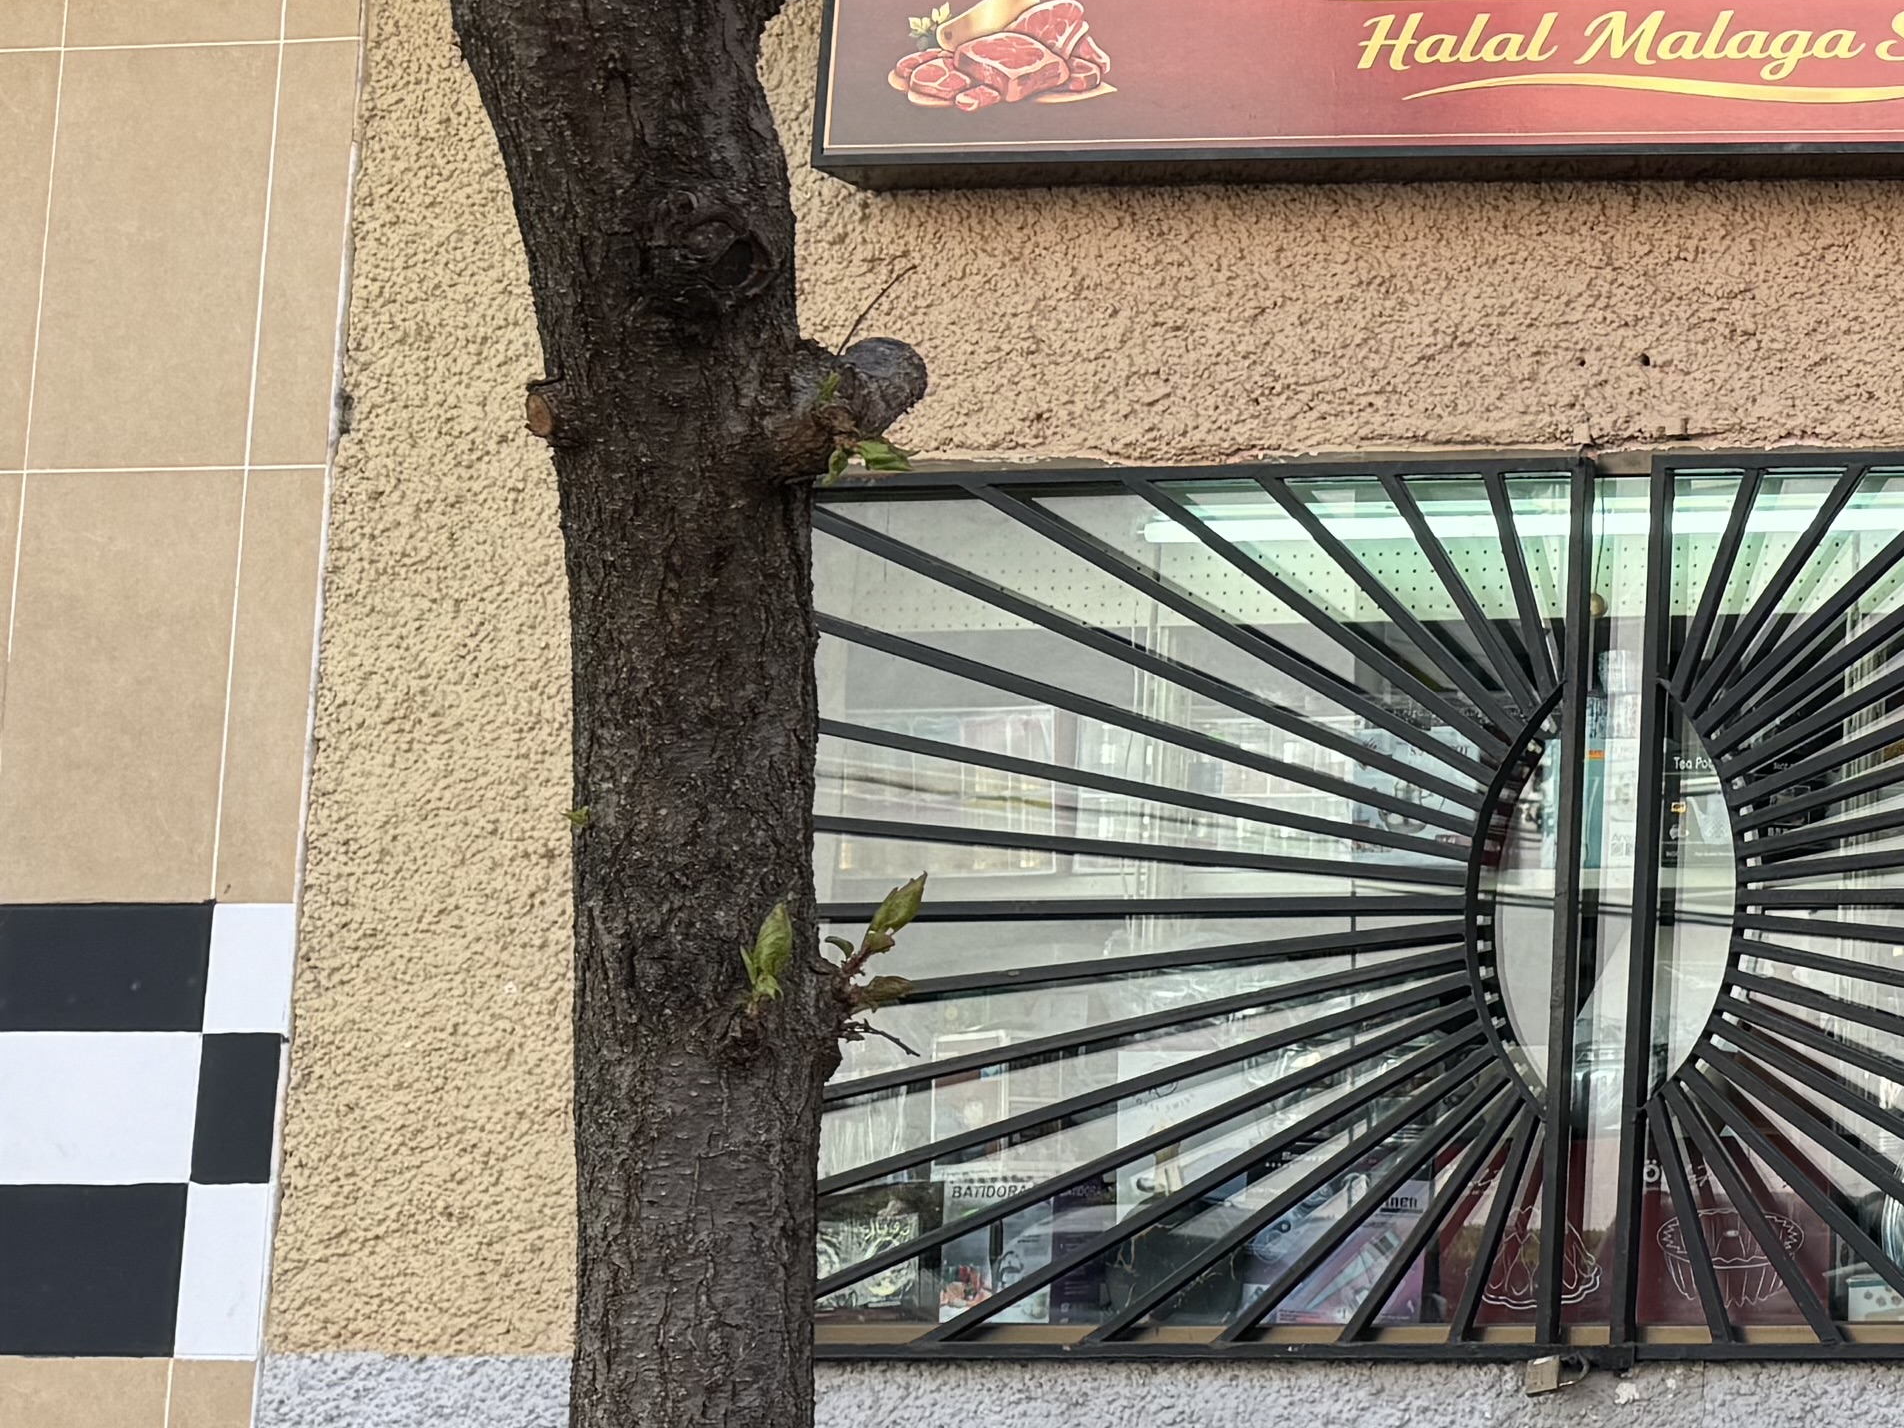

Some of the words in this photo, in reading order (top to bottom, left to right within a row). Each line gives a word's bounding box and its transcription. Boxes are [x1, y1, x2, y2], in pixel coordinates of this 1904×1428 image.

[1358, 12, 1559, 71] Halal
[1582, 10, 1867, 80] Malaga
[1673, 756, 1693, 770] Tea
